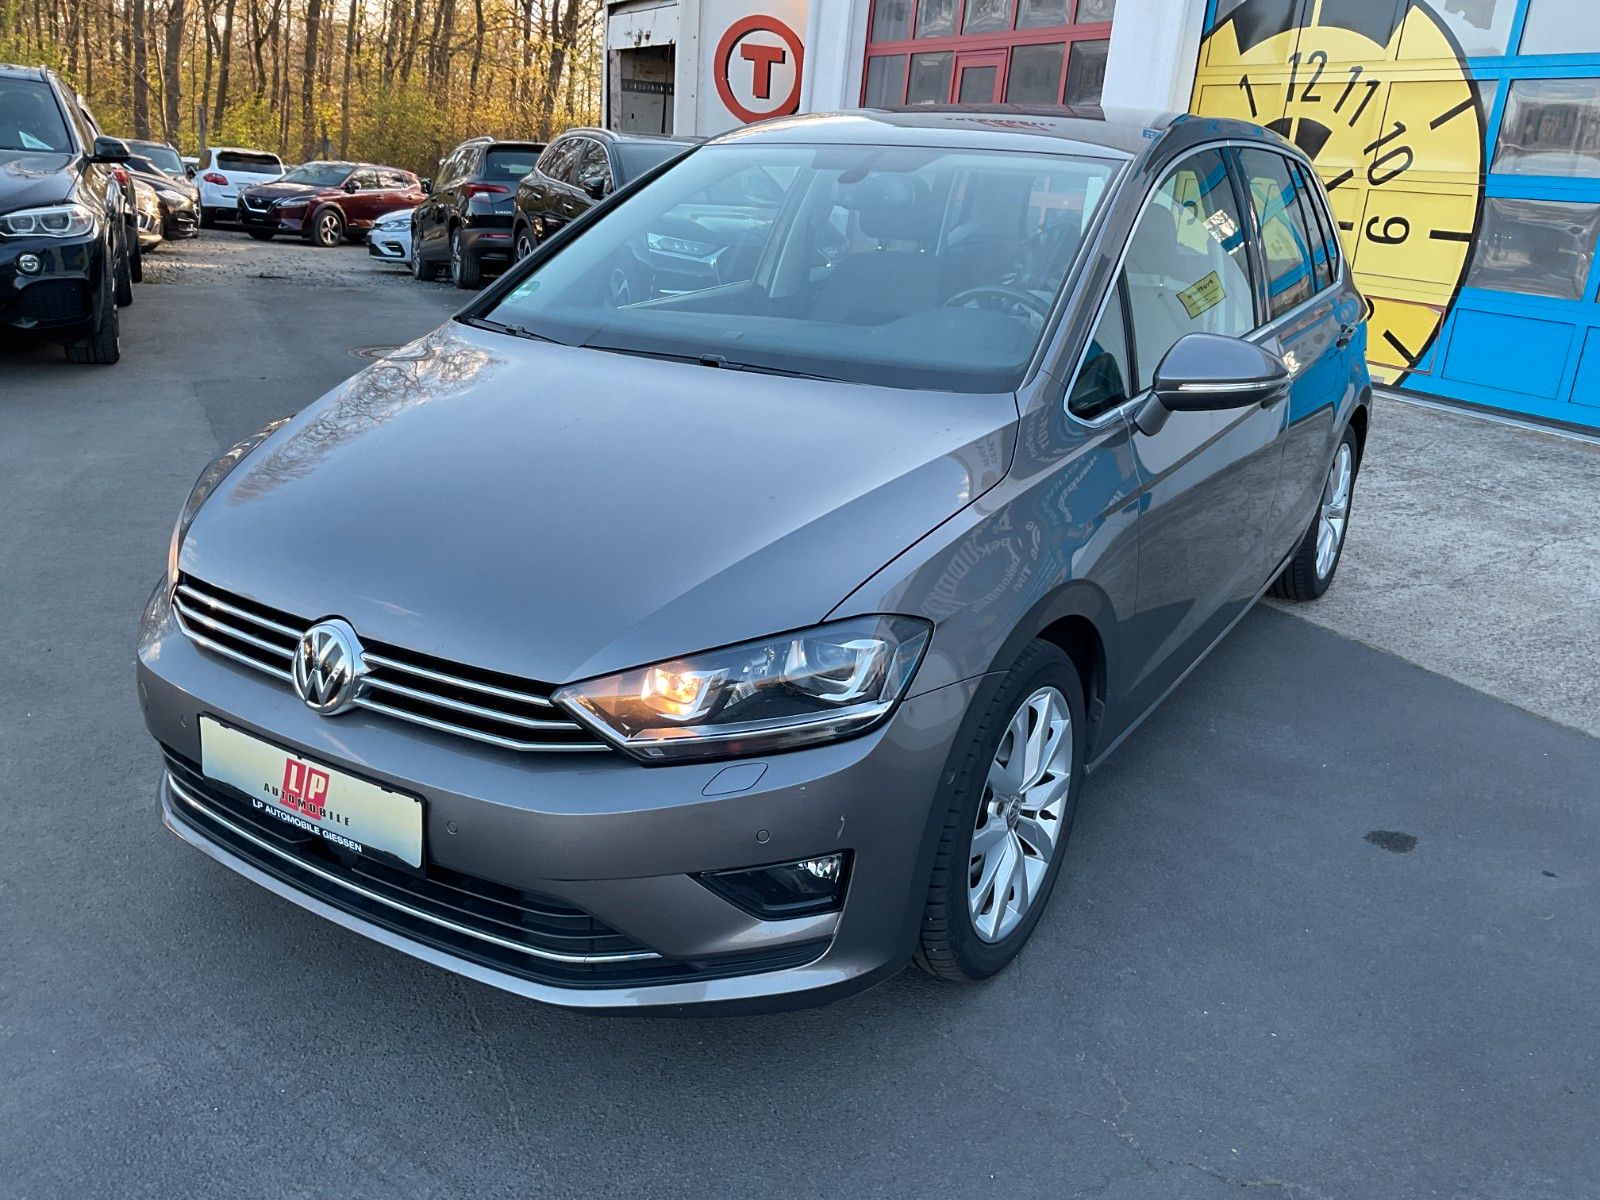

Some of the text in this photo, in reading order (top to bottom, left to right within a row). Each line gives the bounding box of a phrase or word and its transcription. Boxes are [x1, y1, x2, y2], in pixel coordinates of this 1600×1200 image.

[741, 42, 786, 99] T
[1239, 74, 1259, 118] 1
[1286, 50, 1329, 103] 12
[1333, 65, 1381, 127] 11
[1363, 120, 1414, 186] 10
[1365, 215, 1410, 245] 9
[263, 781, 351, 827] AUTOMOBILE
[287, 763, 327, 800] LP
[252, 798, 363, 853] LP AUTOMOBILE GIESSEN
